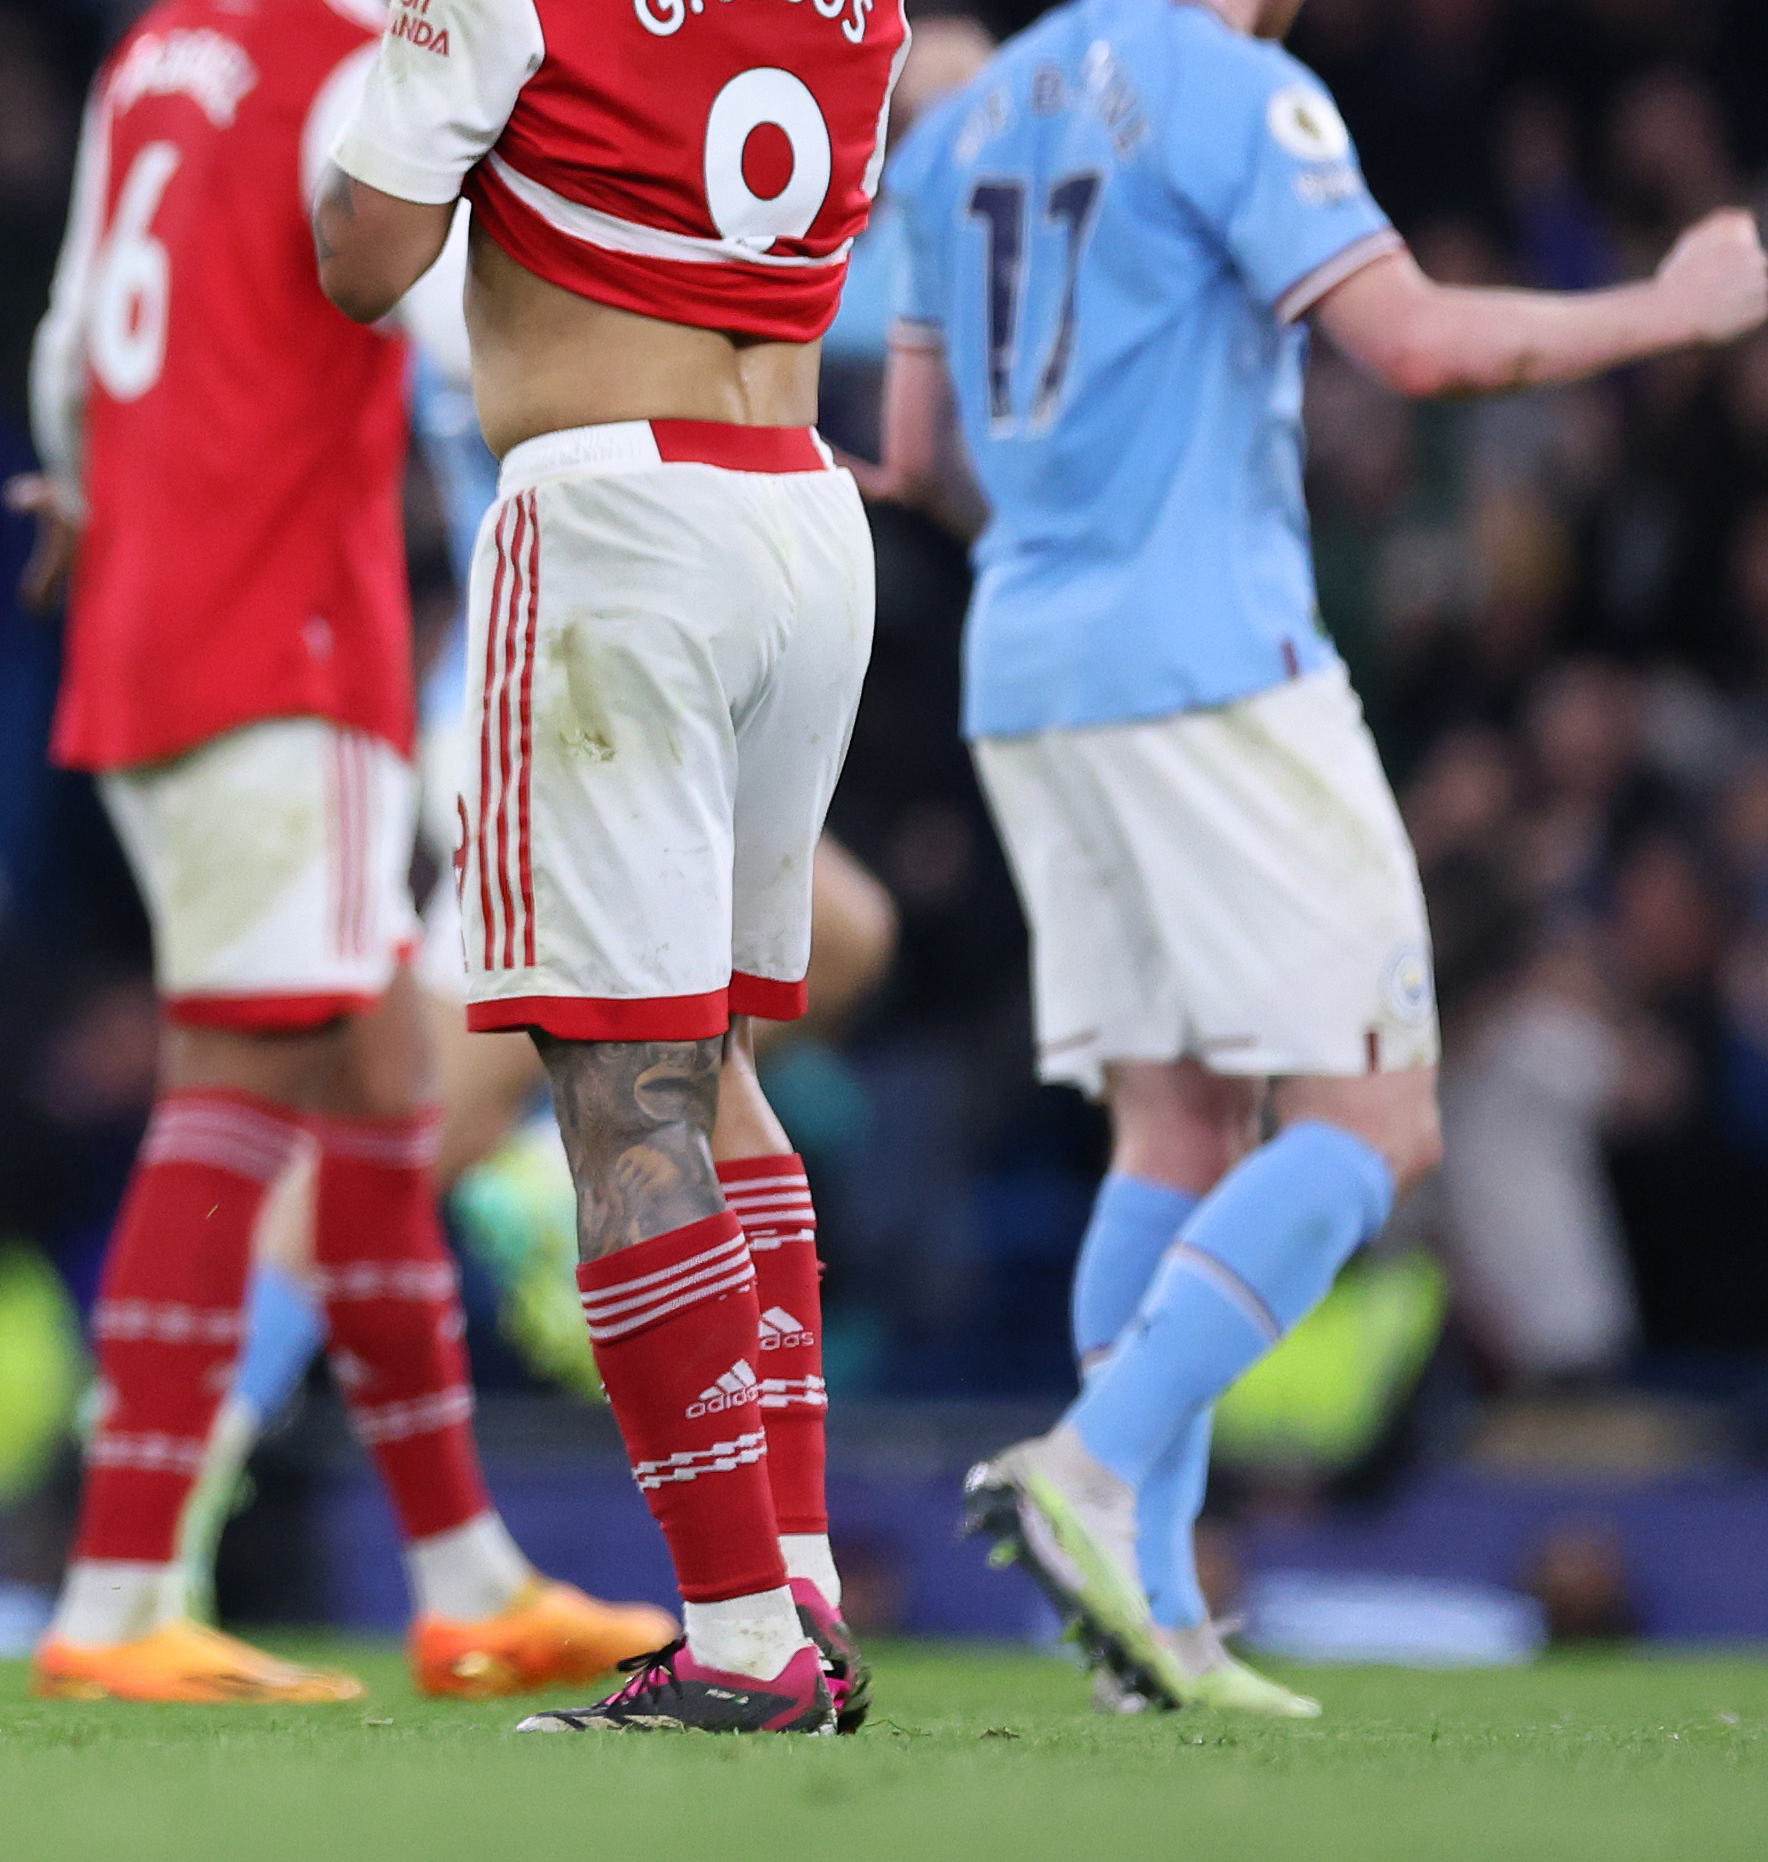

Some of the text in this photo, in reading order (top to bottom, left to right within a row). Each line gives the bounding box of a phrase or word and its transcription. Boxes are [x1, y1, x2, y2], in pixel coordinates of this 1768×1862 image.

[90, 138, 183, 403] 6
[966, 172, 1104, 434] 17
[685, 1384, 759, 1419] adida
